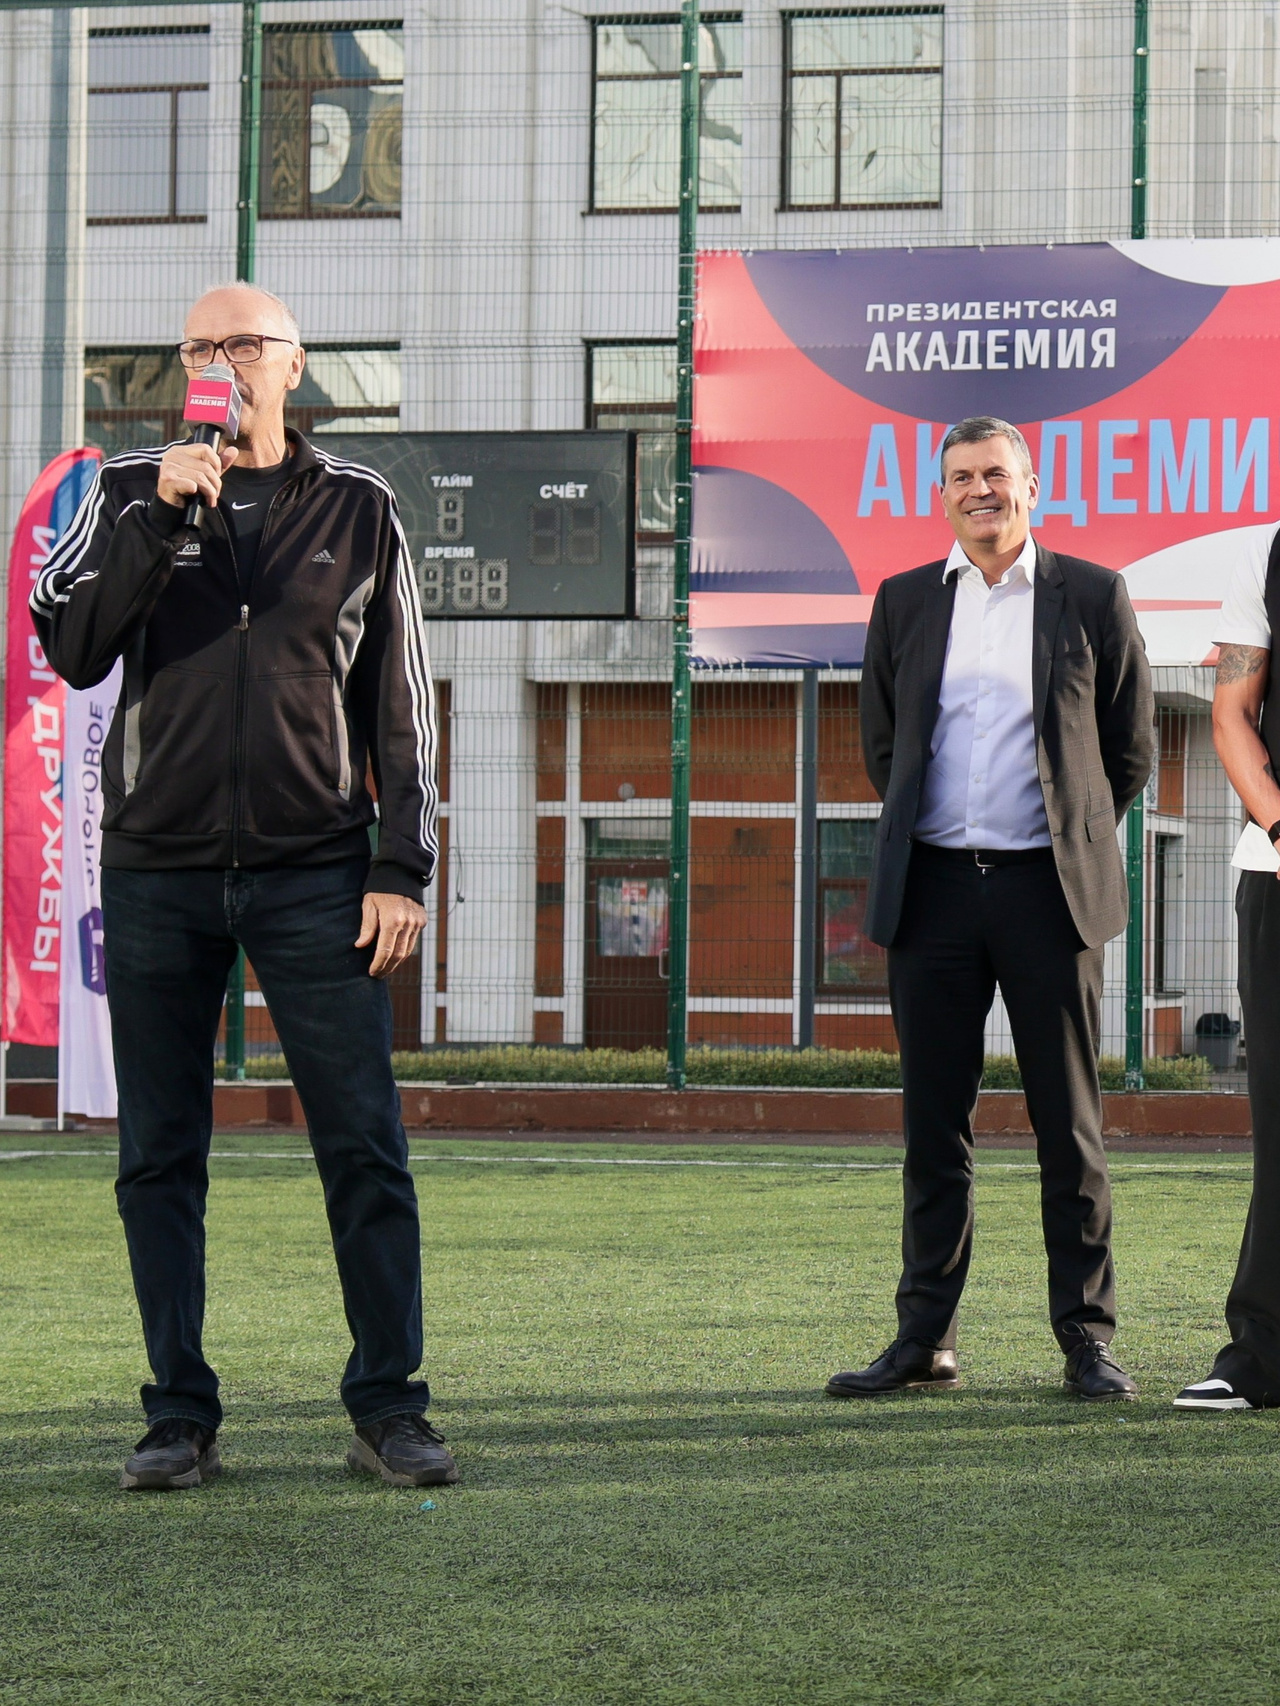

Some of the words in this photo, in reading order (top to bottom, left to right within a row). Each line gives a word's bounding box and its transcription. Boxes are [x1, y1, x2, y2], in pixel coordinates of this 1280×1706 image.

[866, 299, 1117, 322] ПРЕЗИДЕНТСКАЯ
[865, 327, 1117, 373] АКАДЕМИЯ
[189, 398, 227, 407] АКАДЕМИЯ
[431, 474, 473, 487] ТАЙМ
[539, 481, 588, 499] СЧЁТ
[424, 546, 475, 559] ВРЕМЯ
